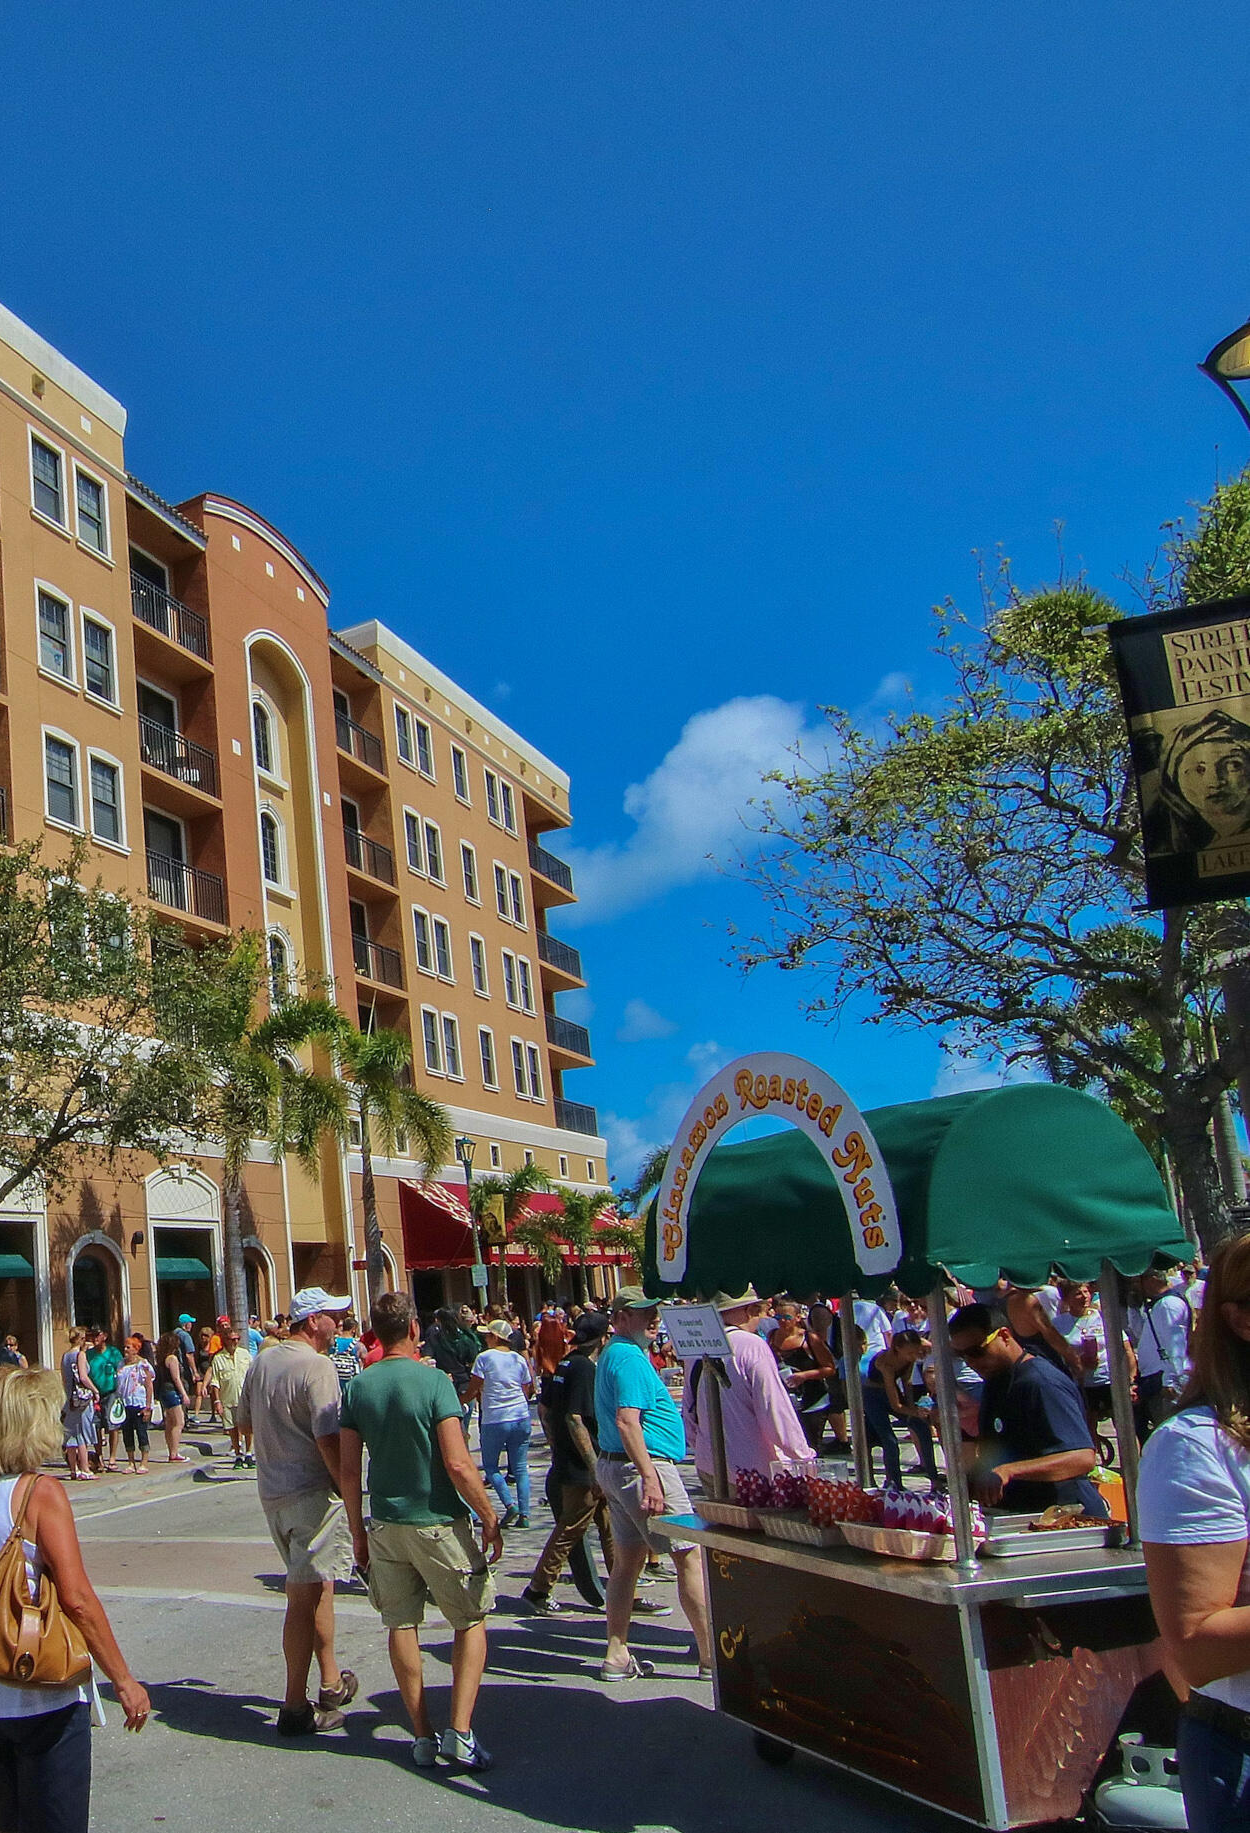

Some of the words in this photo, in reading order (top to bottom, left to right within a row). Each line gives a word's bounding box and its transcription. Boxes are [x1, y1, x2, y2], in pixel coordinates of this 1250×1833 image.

[662, 1092, 730, 1263] Cinnamon
[733, 1068, 844, 1138] Roasted
[832, 1130, 885, 1250] Nuts
